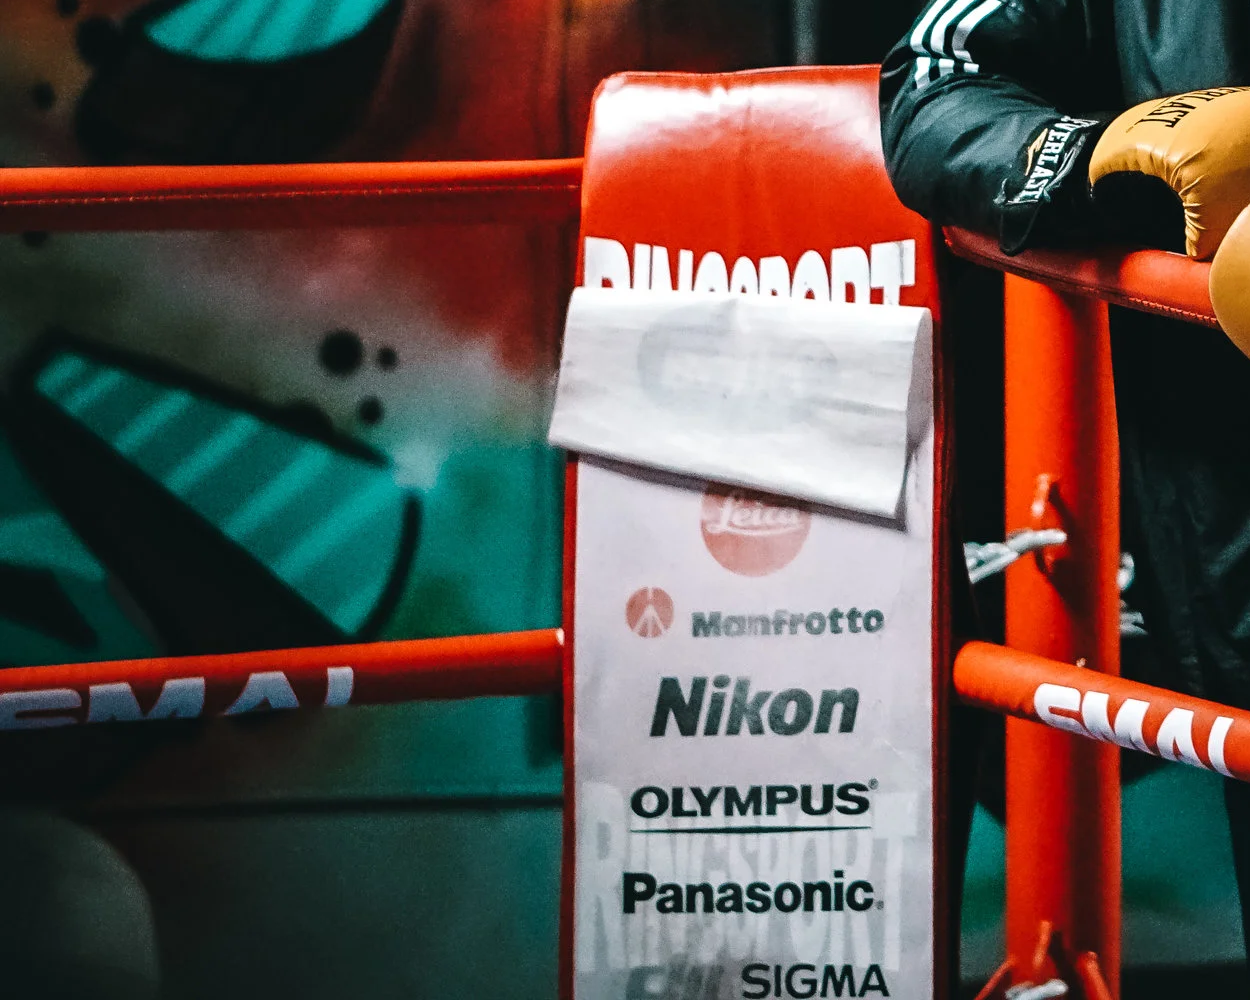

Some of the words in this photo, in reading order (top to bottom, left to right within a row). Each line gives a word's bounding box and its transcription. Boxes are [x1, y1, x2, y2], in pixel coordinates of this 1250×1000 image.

[1014, 115, 1099, 201] EVERLAST
[691, 607, 885, 637] Manfrotto
[650, 675, 860, 736] Nikon
[630, 782, 871, 818] OLYMPUS
[622, 870, 874, 914] Panasonic
[741, 963, 890, 999] SIGMA
